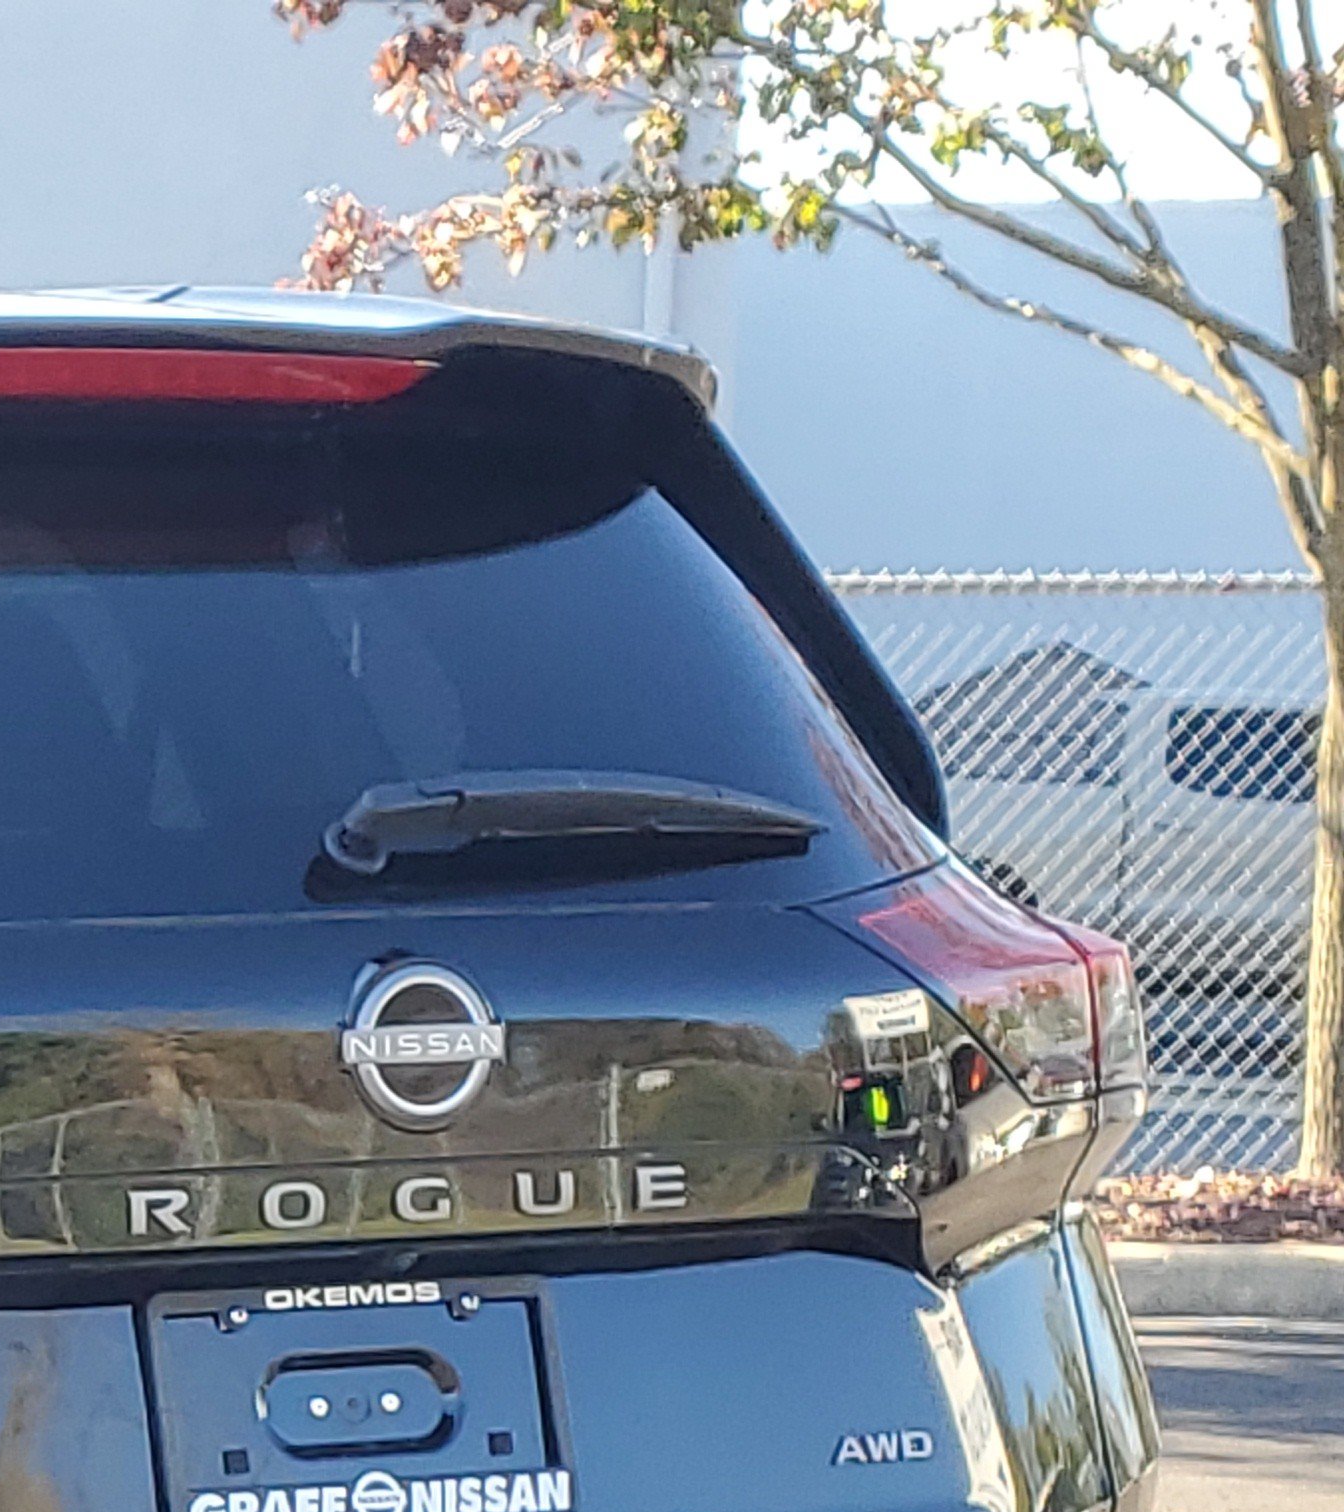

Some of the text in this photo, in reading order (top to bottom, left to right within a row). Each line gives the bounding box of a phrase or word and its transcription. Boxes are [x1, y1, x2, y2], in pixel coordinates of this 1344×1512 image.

[349, 1030, 499, 1060] NISSAN
[128, 1164, 688, 1235] ROGUE
[265, 1281, 440, 1310] OKEMOS
[832, 1429, 933, 1465] AWD
